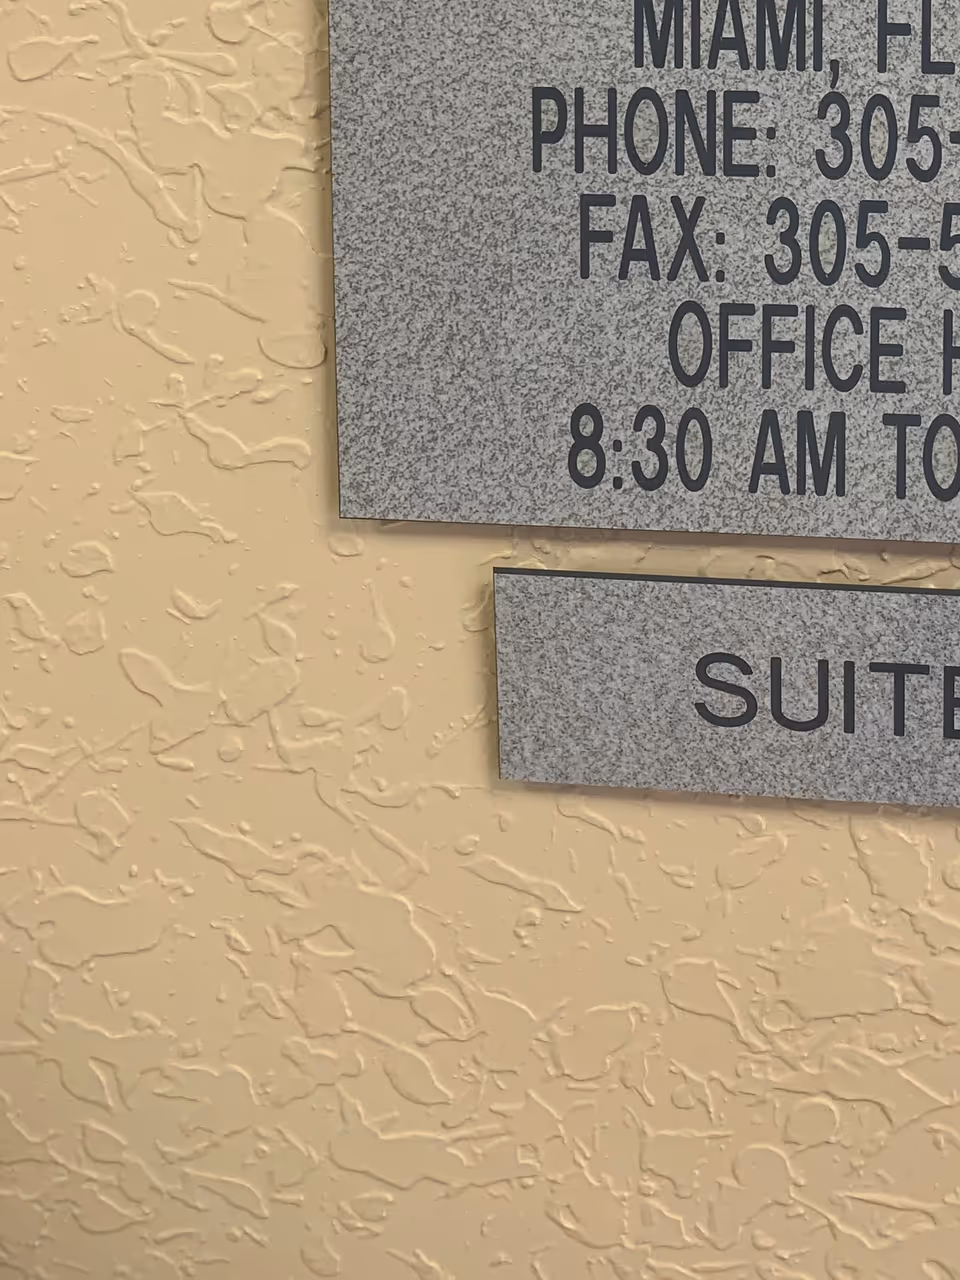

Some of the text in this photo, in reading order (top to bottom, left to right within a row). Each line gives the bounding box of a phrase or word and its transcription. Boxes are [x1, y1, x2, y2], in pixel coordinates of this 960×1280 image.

[531, 86, 778, 179] PHONE:
[579, 193, 726, 283] FAX:
[668, 300, 907, 394] OFFICE
[567, 402, 713, 492] 8:30
[748, 409, 846, 497] AM
